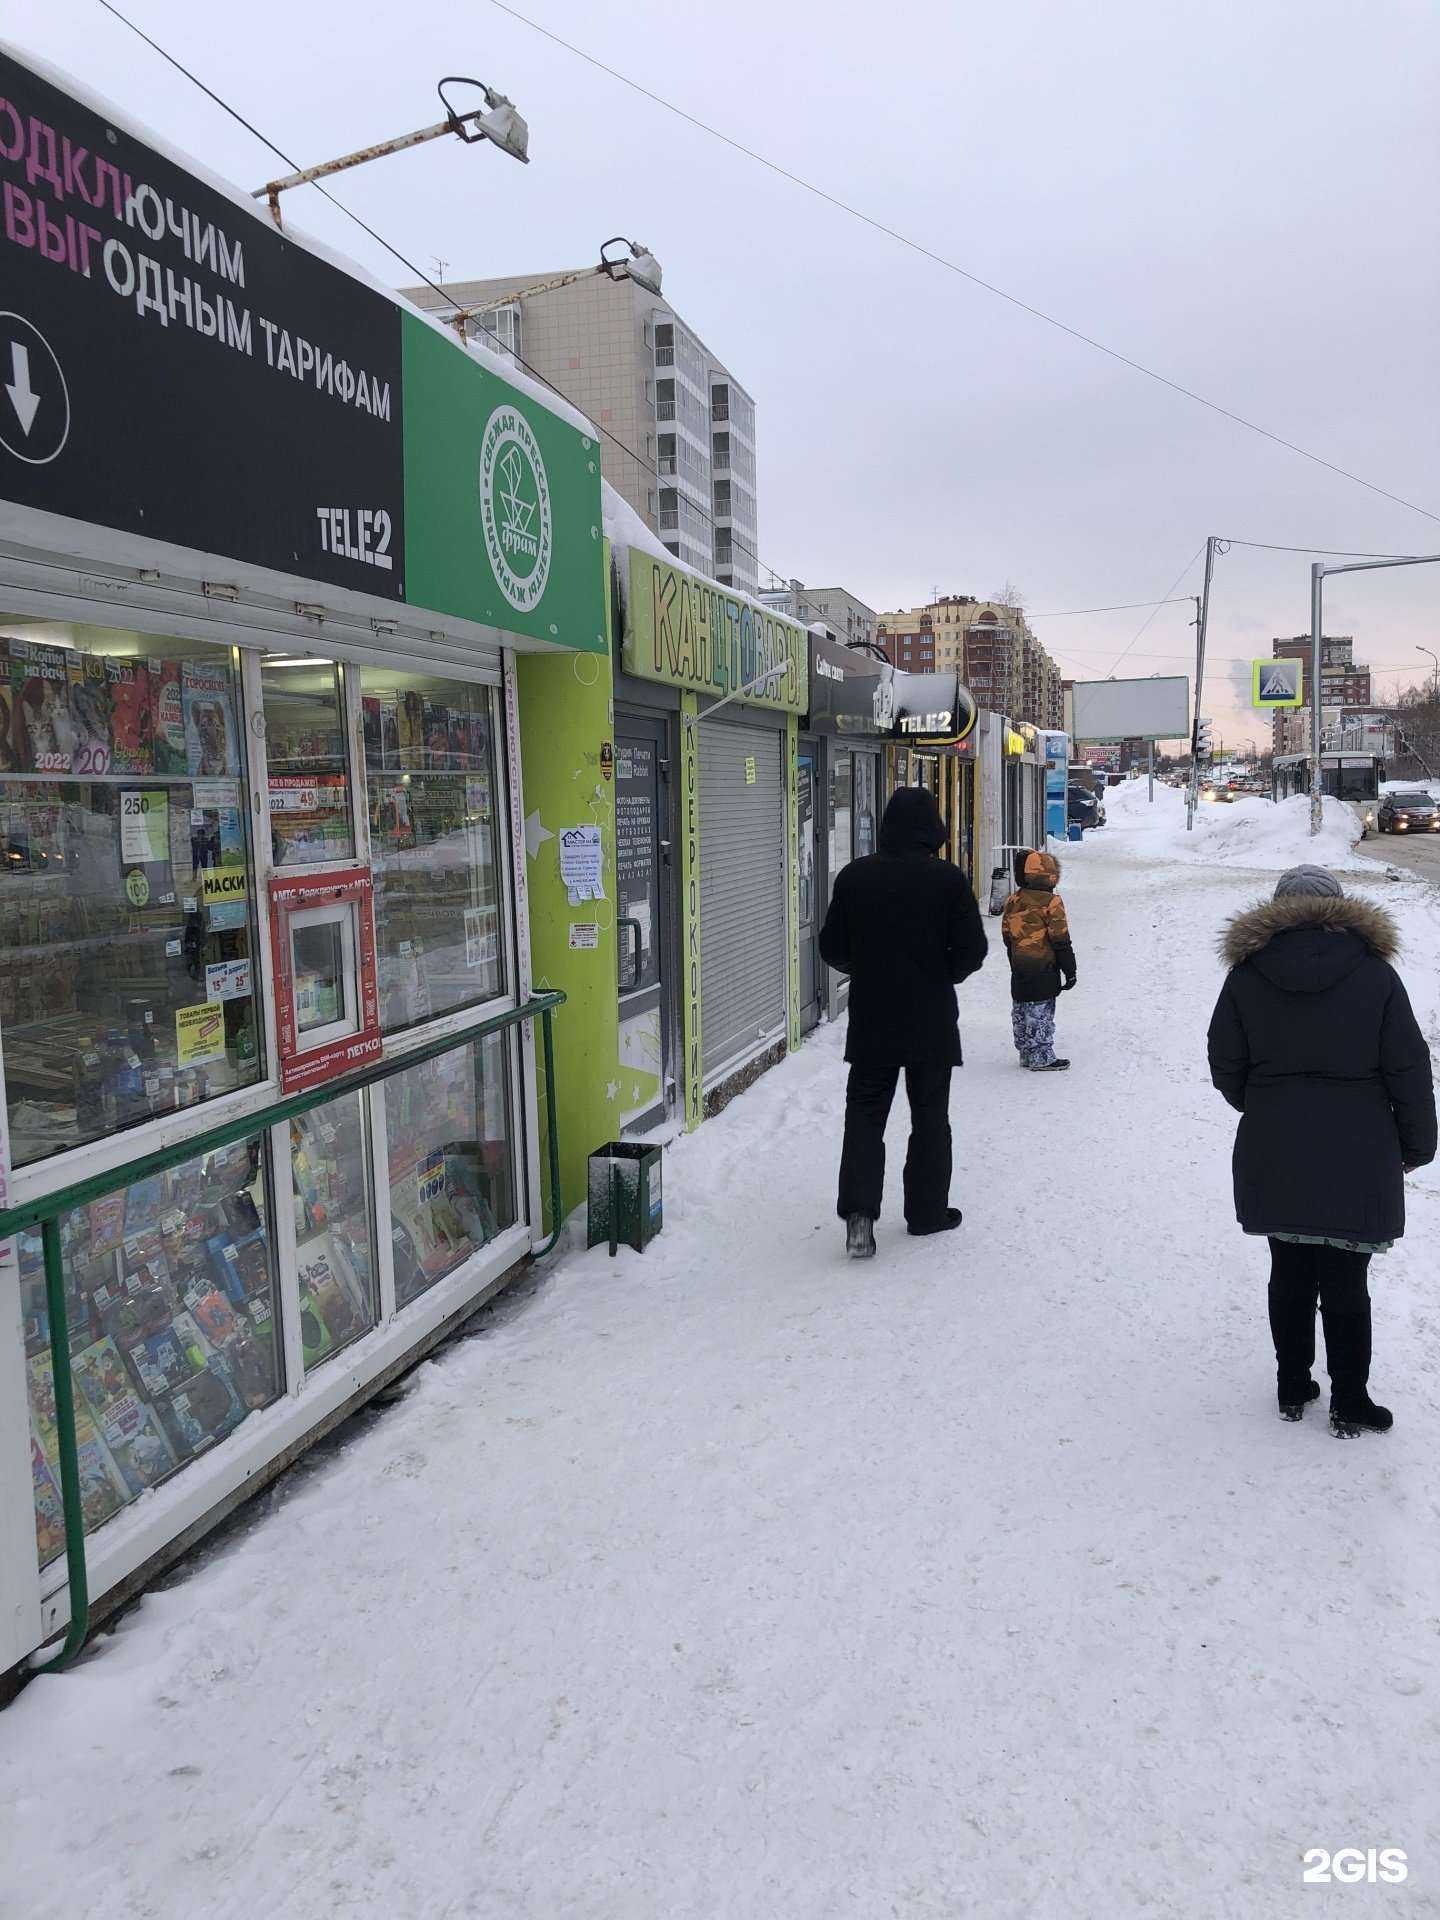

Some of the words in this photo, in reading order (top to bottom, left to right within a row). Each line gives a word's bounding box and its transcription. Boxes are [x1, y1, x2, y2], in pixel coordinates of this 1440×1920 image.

[3, 180, 254, 357] ВЫГОДНЫМ
[259, 316, 391, 423] ТАРИФАМ
[483, 414, 516, 475] СВЕЖАЯ
[517, 422, 547, 502] ПРЕССА
[316, 505, 393, 571] TELE2
[528, 520, 550, 601] ГАЗЕТЫ
[652, 564, 801, 706] КАНЦТОВАРЫ
[900, 711, 952, 733] TELE2
[35, 752, 72, 770] 2022
[124, 797, 150, 816] 250
[269, 798, 285, 810] 022
[204, 875, 246, 895] МАСКИ
[278, 888, 297, 901] МТС
[354, 878, 371, 889] МТС
[212, 980, 221, 992] 15
[235, 975, 244, 988] 25
[346, 1037, 382, 1059] ЛЕГКО!
